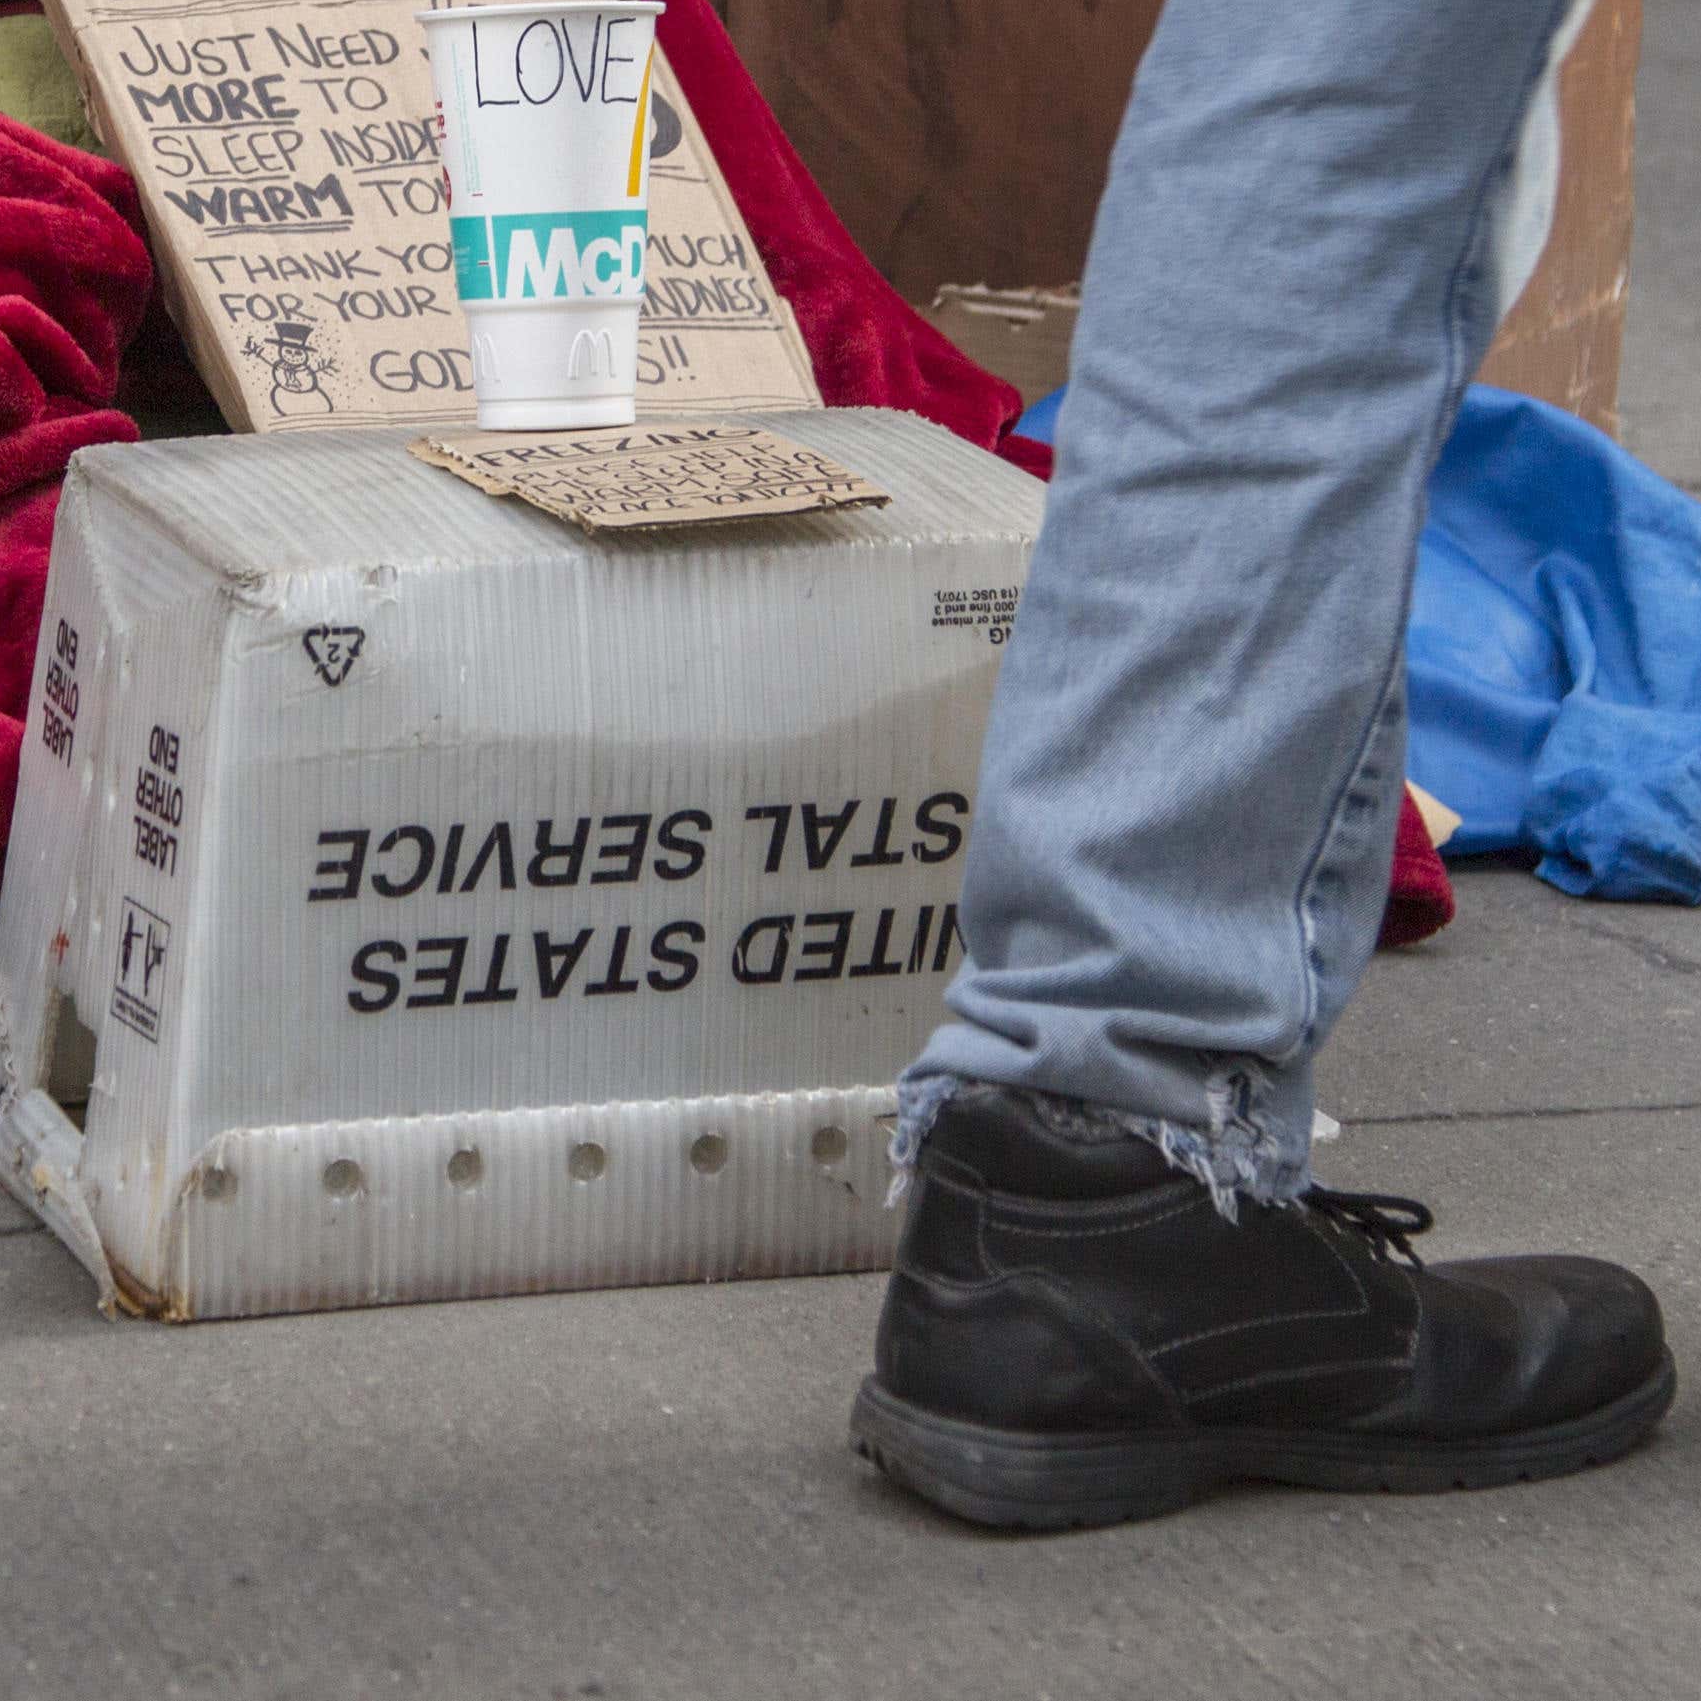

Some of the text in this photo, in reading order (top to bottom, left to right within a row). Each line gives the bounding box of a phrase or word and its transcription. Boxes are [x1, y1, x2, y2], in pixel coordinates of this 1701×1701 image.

[119, 25, 255, 77] JUST
[265, 22, 400, 70] NEED
[471, 14, 637, 108] LOVE
[126, 73, 388, 123] MORE TO
[152, 129, 303, 177] SLEEP
[164, 173, 354, 225] WARM
[193, 248, 382, 285] THANK
[219, 291, 318, 323] FOR
[313, 284, 452, 322] YOUR
[369, 347, 475, 393] GOD
[474, 429, 761, 467] FREEZING
[511, 444, 775, 484] PLEASE HELP
[531, 451, 827, 494] ME SLEEP IN A
[718, 463, 848, 488] SAFE
[579, 497, 694, 516] PLACE
[934, 604, 942, 615] 3
[944, 603, 966, 615] and
[969, 602, 991, 613] fine
[971, 589, 998, 601] USC
[931, 615, 974, 627] misuse
[977, 615, 989, 625] or
[56, 617, 78, 671] END
[327, 643, 341, 664] 2
[45, 655, 79, 722] OTHER
[43, 701, 74, 769] LABEL
[149, 723, 180, 776] END
[135, 765, 183, 828] OTHER
[133, 814, 178, 877] LABEL
[307, 808, 713, 903] SERVICE
[347, 902, 968, 1013] NITED STATES
